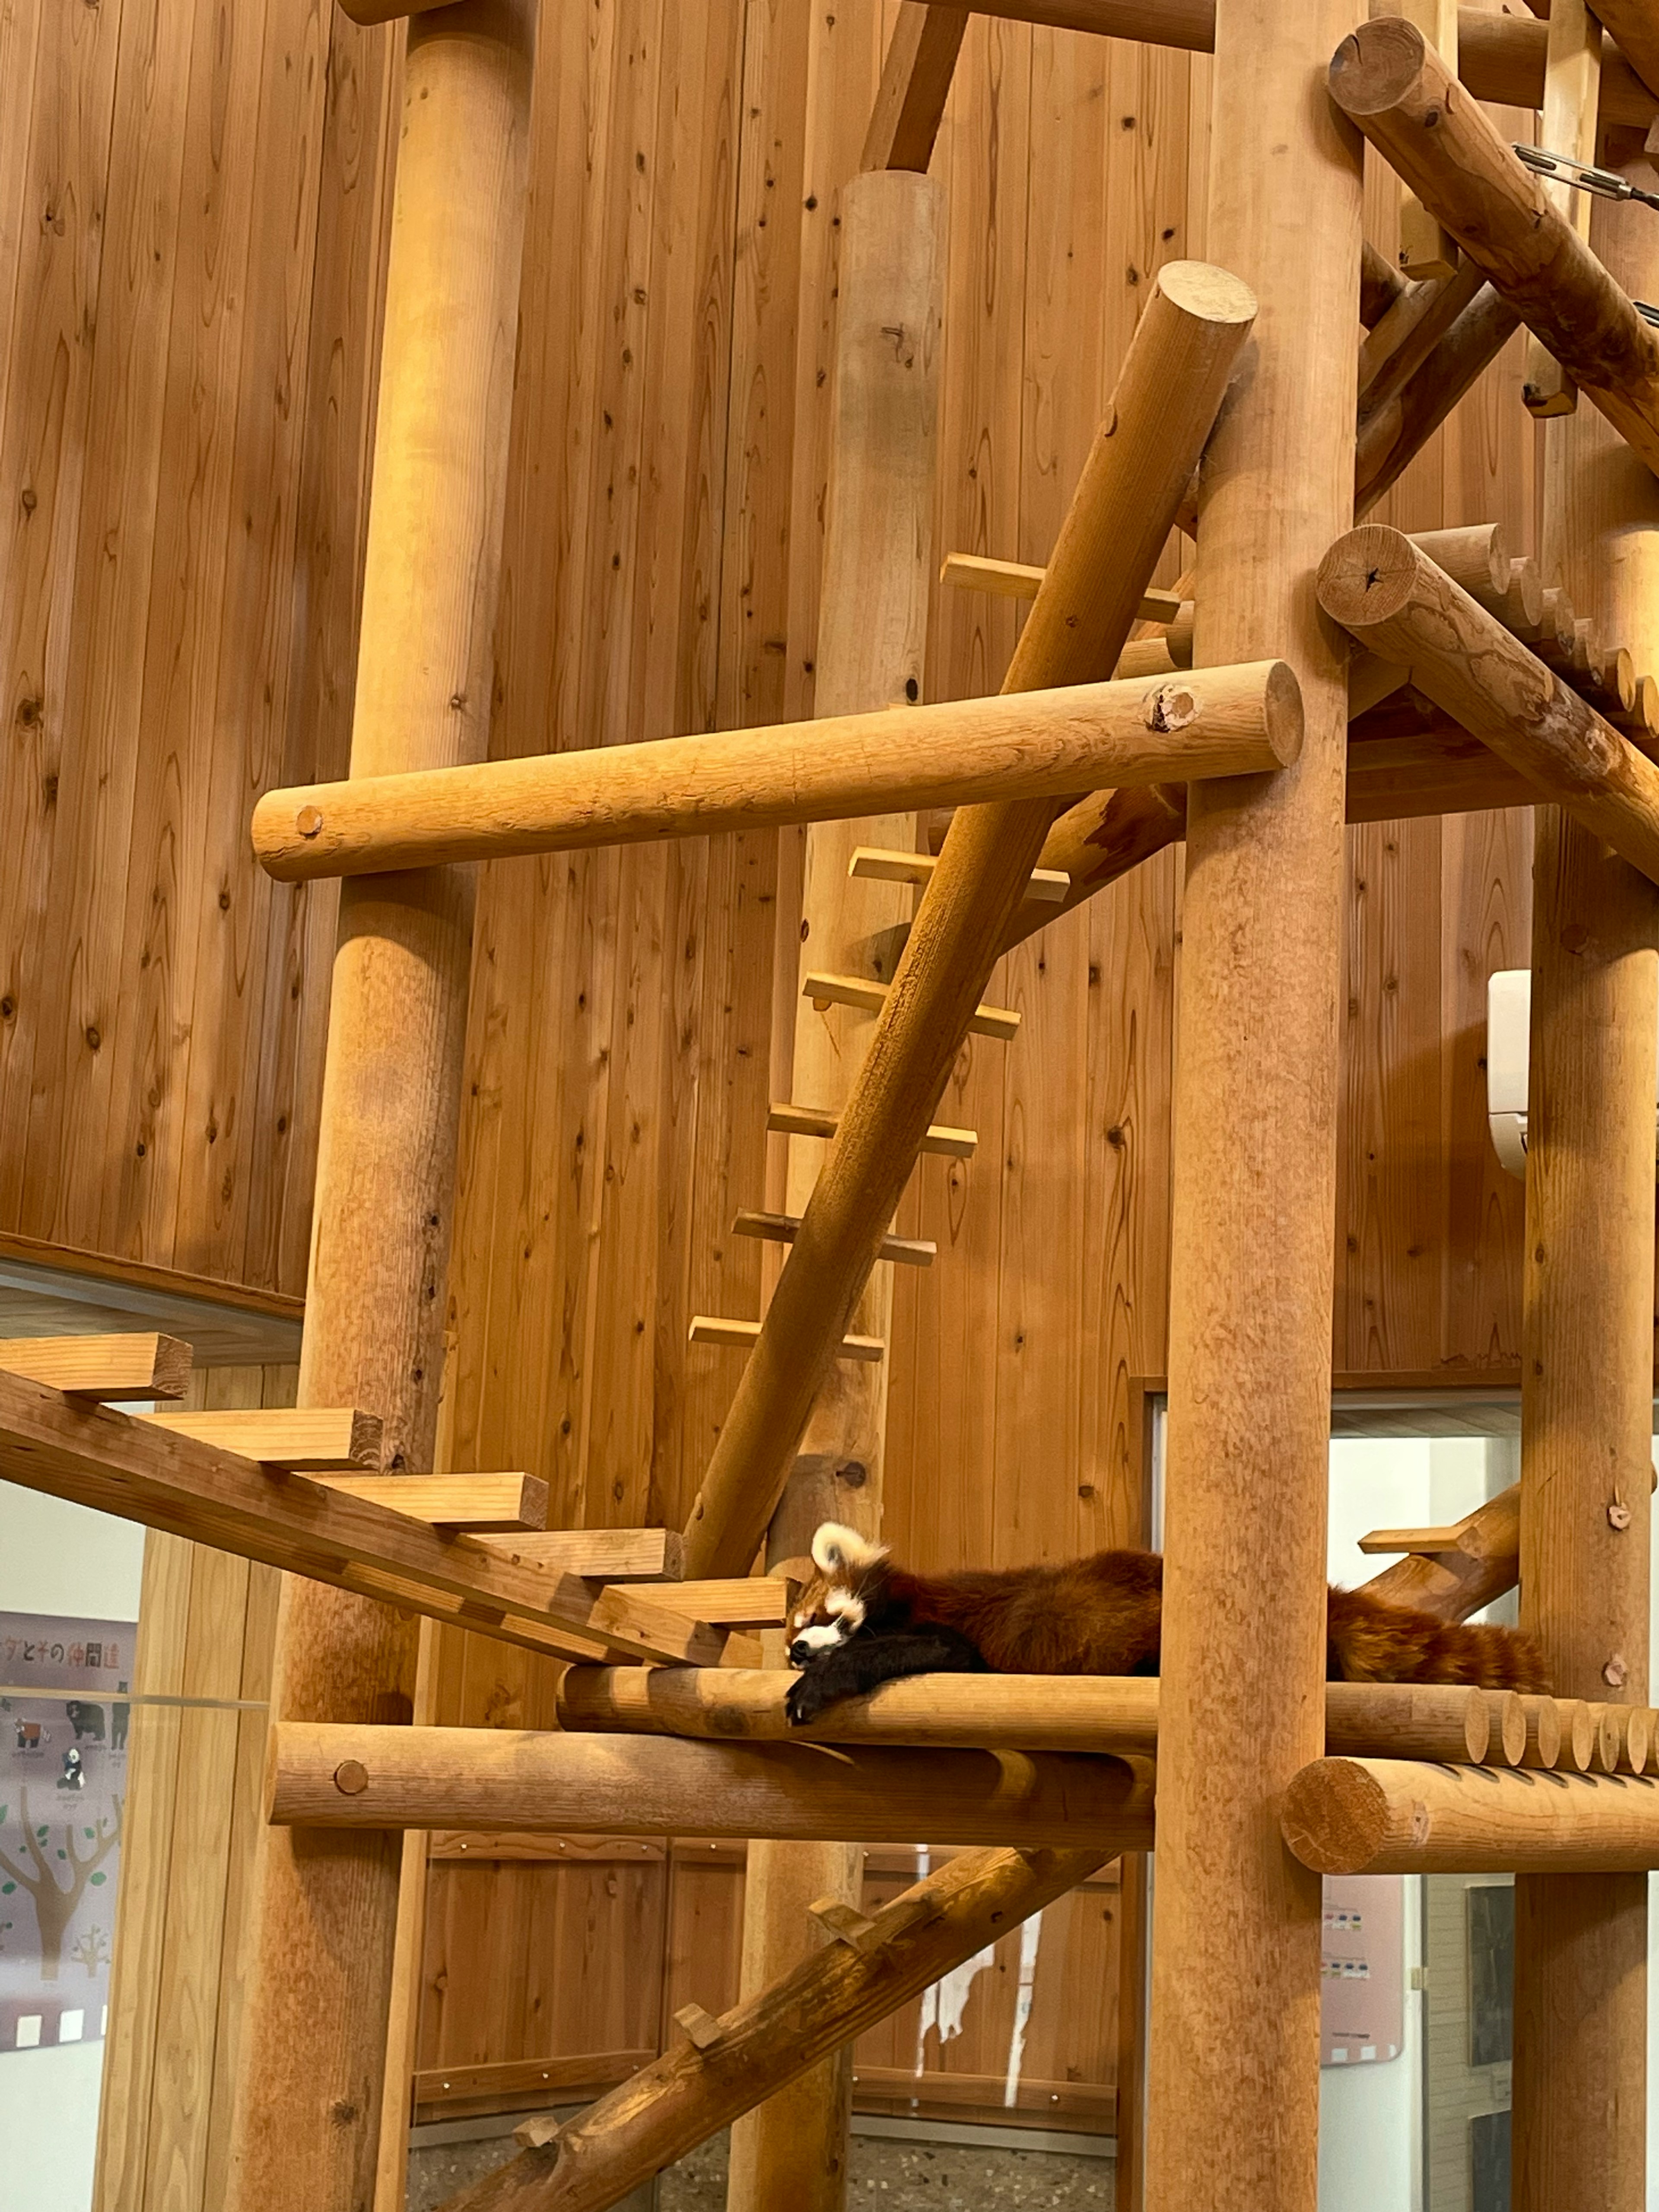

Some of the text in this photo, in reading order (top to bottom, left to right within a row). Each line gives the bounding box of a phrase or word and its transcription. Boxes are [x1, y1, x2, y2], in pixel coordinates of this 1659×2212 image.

[0, 1637, 119, 1669] ダとその仲間達
